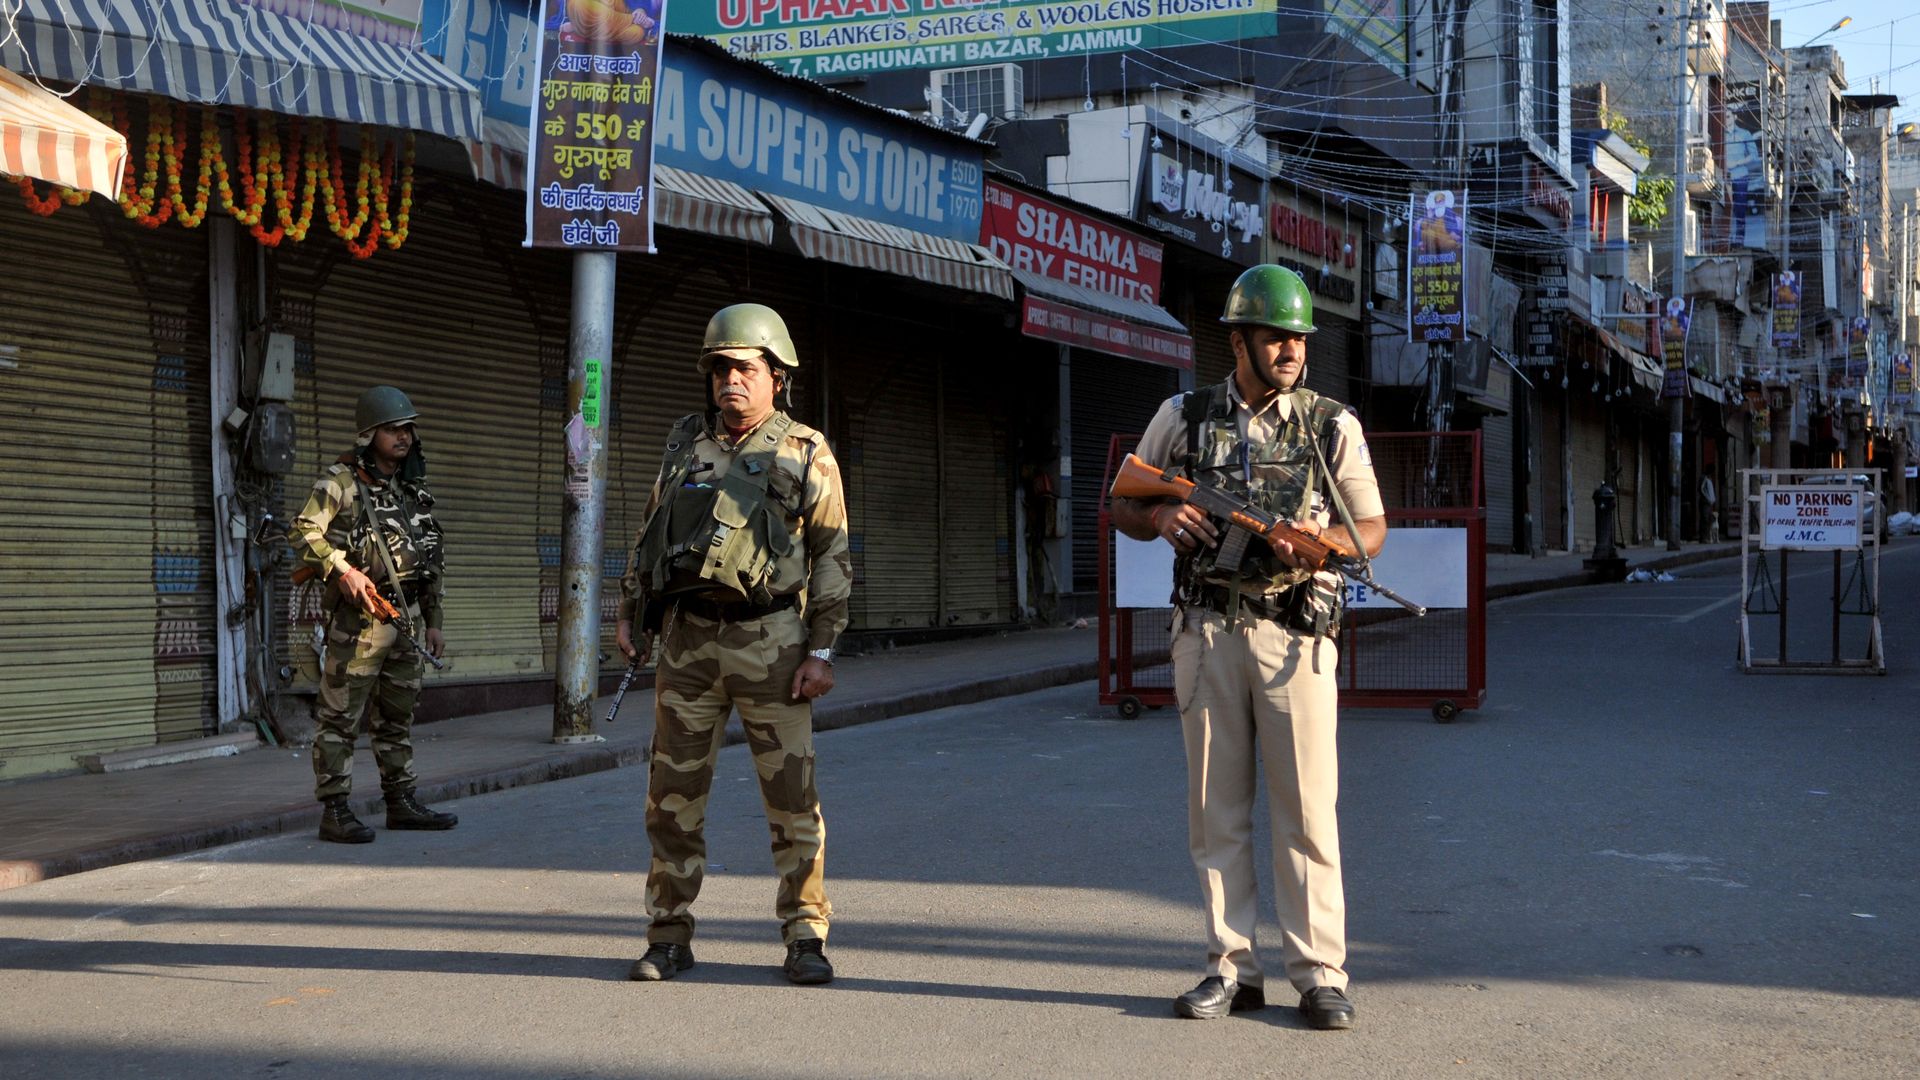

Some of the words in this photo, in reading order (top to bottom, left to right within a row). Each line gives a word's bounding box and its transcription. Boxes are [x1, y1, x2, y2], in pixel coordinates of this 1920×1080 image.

[1017, 11, 1032, 28] &
[1037, 0, 1151, 26] WOOLENS
[1158, 0, 1252, 15] HOSI
[558, 53, 592, 72] आप
[816, 45, 957, 75] RAGHUNATH
[965, 37, 1049, 61] BAZAR,
[1056, 27, 1142, 53] JAMMU
[542, 80, 569, 111] गुरु
[571, 82, 611, 102] नानक
[612, 77, 631, 104] देव
[633, 76, 652, 105] जी
[544, 115, 566, 137] के
[575, 113, 622, 141] 550
[627, 119, 646, 141] वें
[553, 145, 633, 181] गुरुपूरब
[698, 79, 829, 193] SUPER
[837, 126, 946, 222] STORE
[951, 159, 978, 185] ESTD
[541, 181, 561, 208] की
[562, 184, 605, 211] हार्दिक
[950, 192, 979, 221] 1970
[561, 218, 595, 245] होवे
[595, 219, 620, 245] जी
[1016, 202, 1139, 274] SHARMA
[989, 235, 1056, 278] DRY
[1063, 259, 1154, 304] FRUITS
[1427, 279, 1450, 293] 550
[1773, 493, 1791, 505] NO
[1795, 493, 1853, 506] PARKING
[1796, 506, 1830, 517] ZONE
[1785, 530, 1826, 542] J.M.C.
